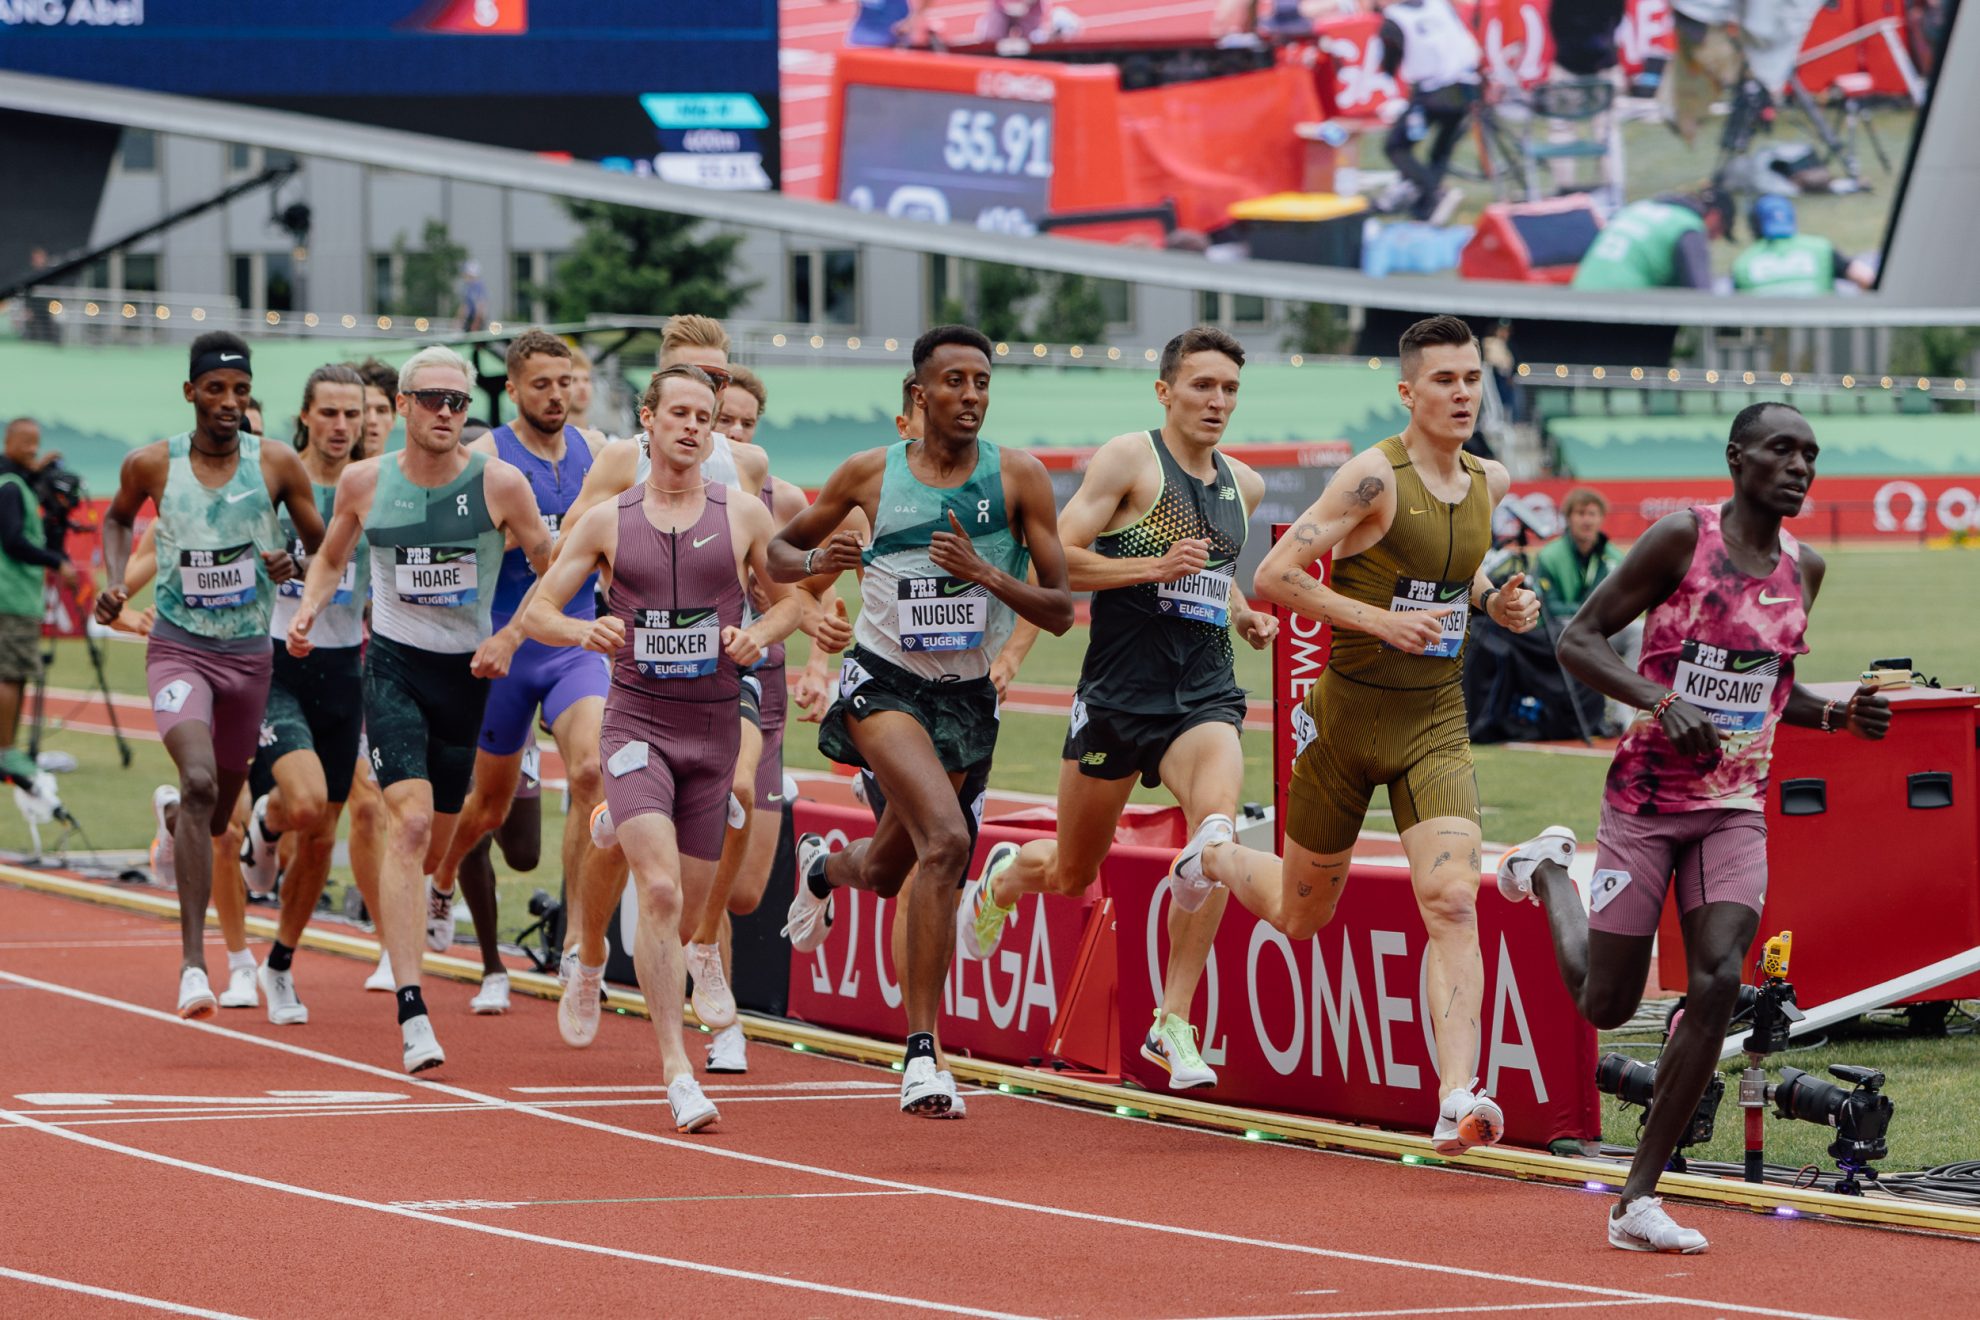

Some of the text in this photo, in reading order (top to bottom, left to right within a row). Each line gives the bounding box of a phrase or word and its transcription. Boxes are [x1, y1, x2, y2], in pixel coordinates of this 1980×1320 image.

[944, 108, 1054, 178] 55.91
[394, 499, 414, 509] OAC
[894, 504, 917, 513] OAC
[190, 550, 214, 567] PRE
[406, 547, 431, 564] PRE
[197, 568, 242, 590] GIRMA
[412, 567, 461, 588] HOARE
[910, 578, 937, 598] PRE
[1407, 579, 1436, 601] PRE
[202, 593, 241, 608] EUGENE
[417, 593, 459, 605] EUGENE
[645, 610, 670, 628] PRE
[911, 603, 975, 627] NUGUSE
[1179, 603, 1215, 620] EUGENE
[646, 633, 707, 655] HOCKER
[922, 635, 967, 647] EUGENE
[1694, 642, 1728, 670] PRE
[655, 664, 698, 674] EUGENE
[841, 664, 860, 686] 14
[1685, 671, 1763, 704] KIPSANG
[1704, 711, 1745, 727] UGENE
